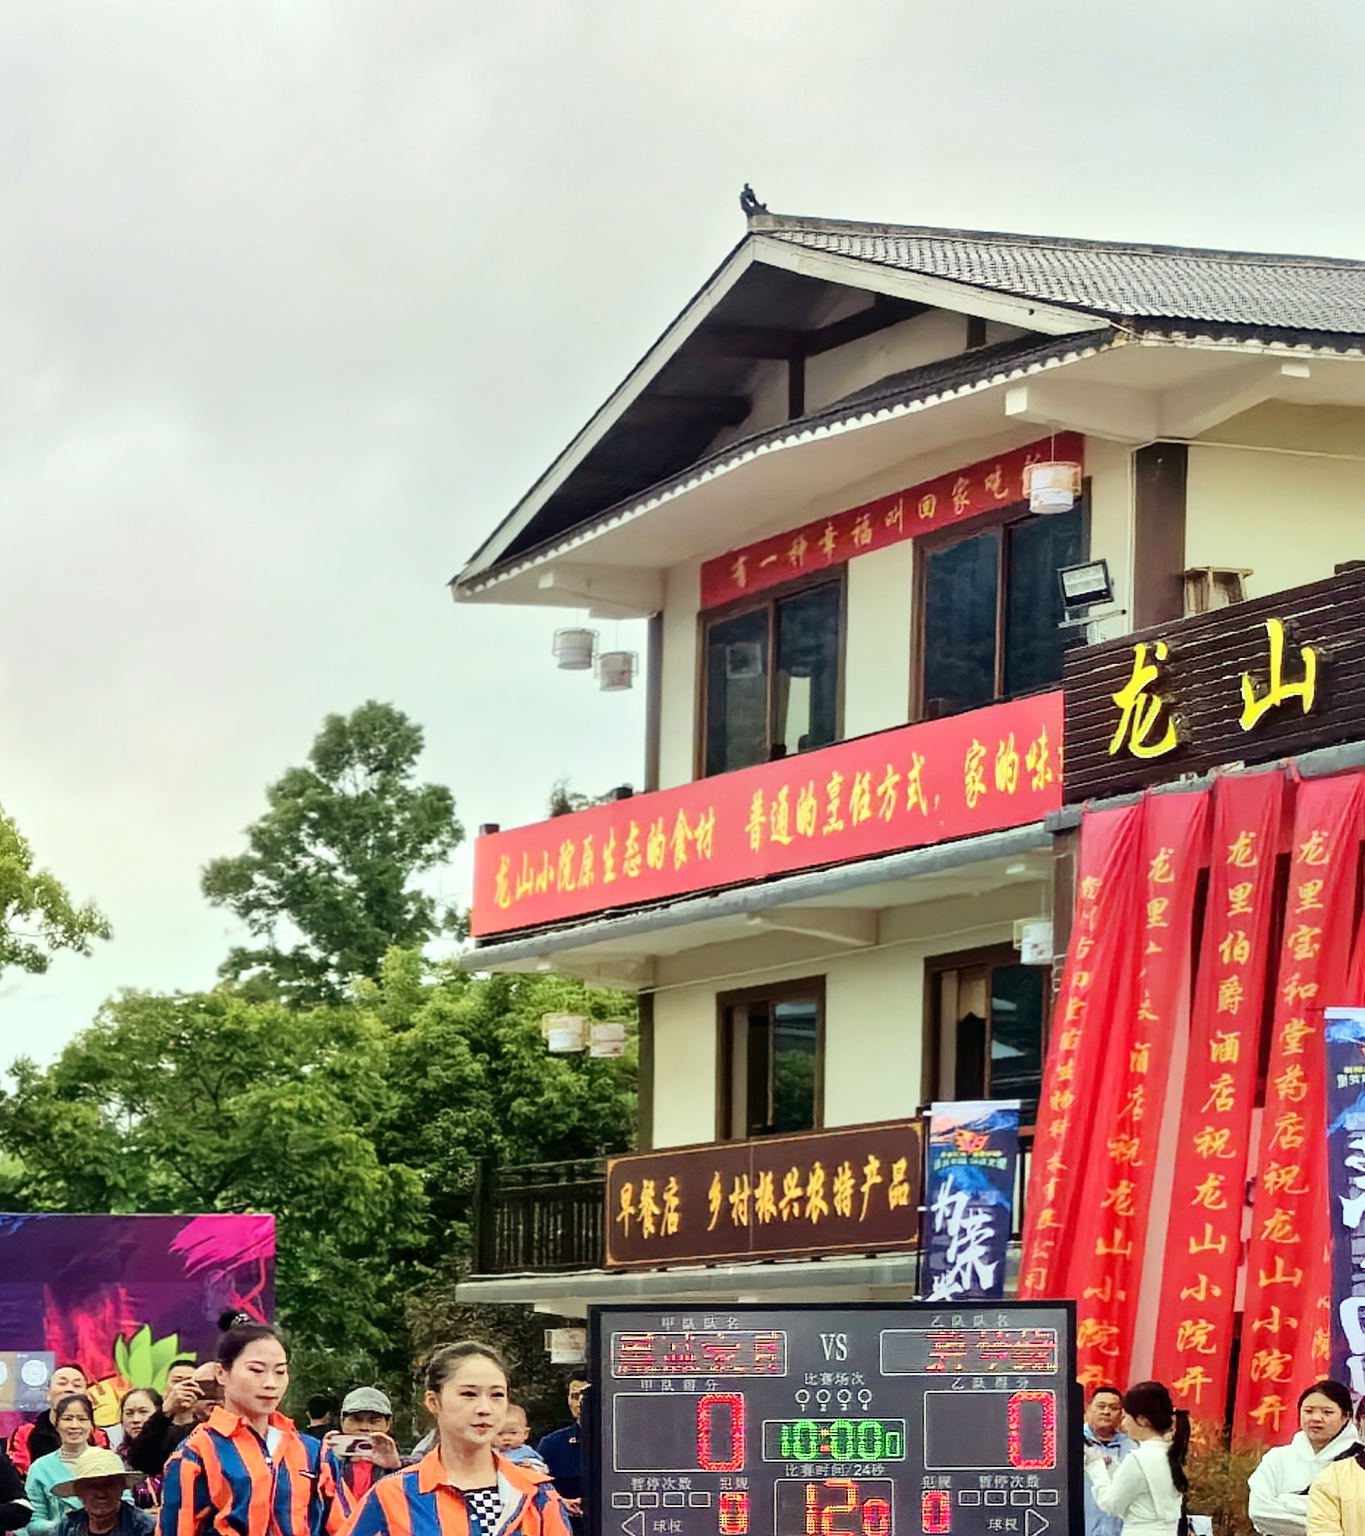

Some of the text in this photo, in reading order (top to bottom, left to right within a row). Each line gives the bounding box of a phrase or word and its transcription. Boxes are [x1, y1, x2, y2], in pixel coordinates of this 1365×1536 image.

[730, 453, 1043, 589] 有一种幸福叫回家吃
[1109, 618, 1317, 759] 龙山
[494, 806, 716, 909] 龙山小院原生态的食材
[964, 724, 1064, 809] 家的味
[1173, 831, 1258, 1445] 龙里伯爵酒店祝龙山小院开
[616, 1154, 911, 1239] 早餐店 乡村振兴农特产品
[819, 1333, 849, 1361] VS
[697, 1393, 746, 1471] 0
[1008, 1391, 1056, 1469] 0
